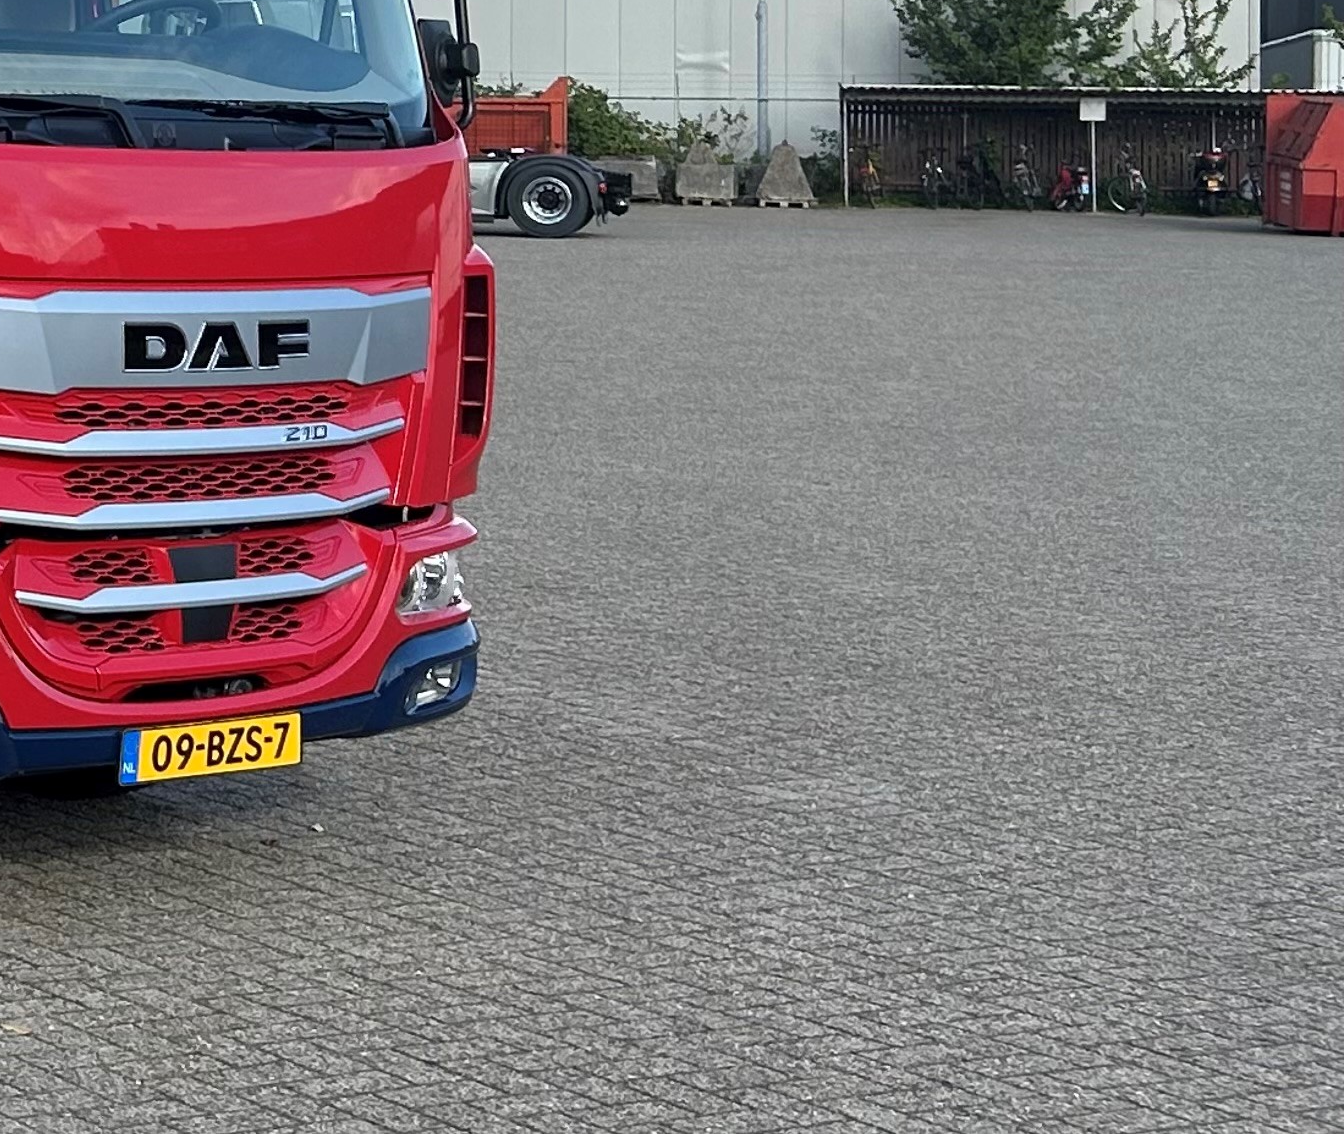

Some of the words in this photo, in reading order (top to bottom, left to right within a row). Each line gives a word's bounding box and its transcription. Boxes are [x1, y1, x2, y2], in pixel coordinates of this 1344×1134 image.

[122, 319, 310, 373] DAF
[283, 424, 328, 442] 210
[152, 721, 291, 772] 09-BZS-7
